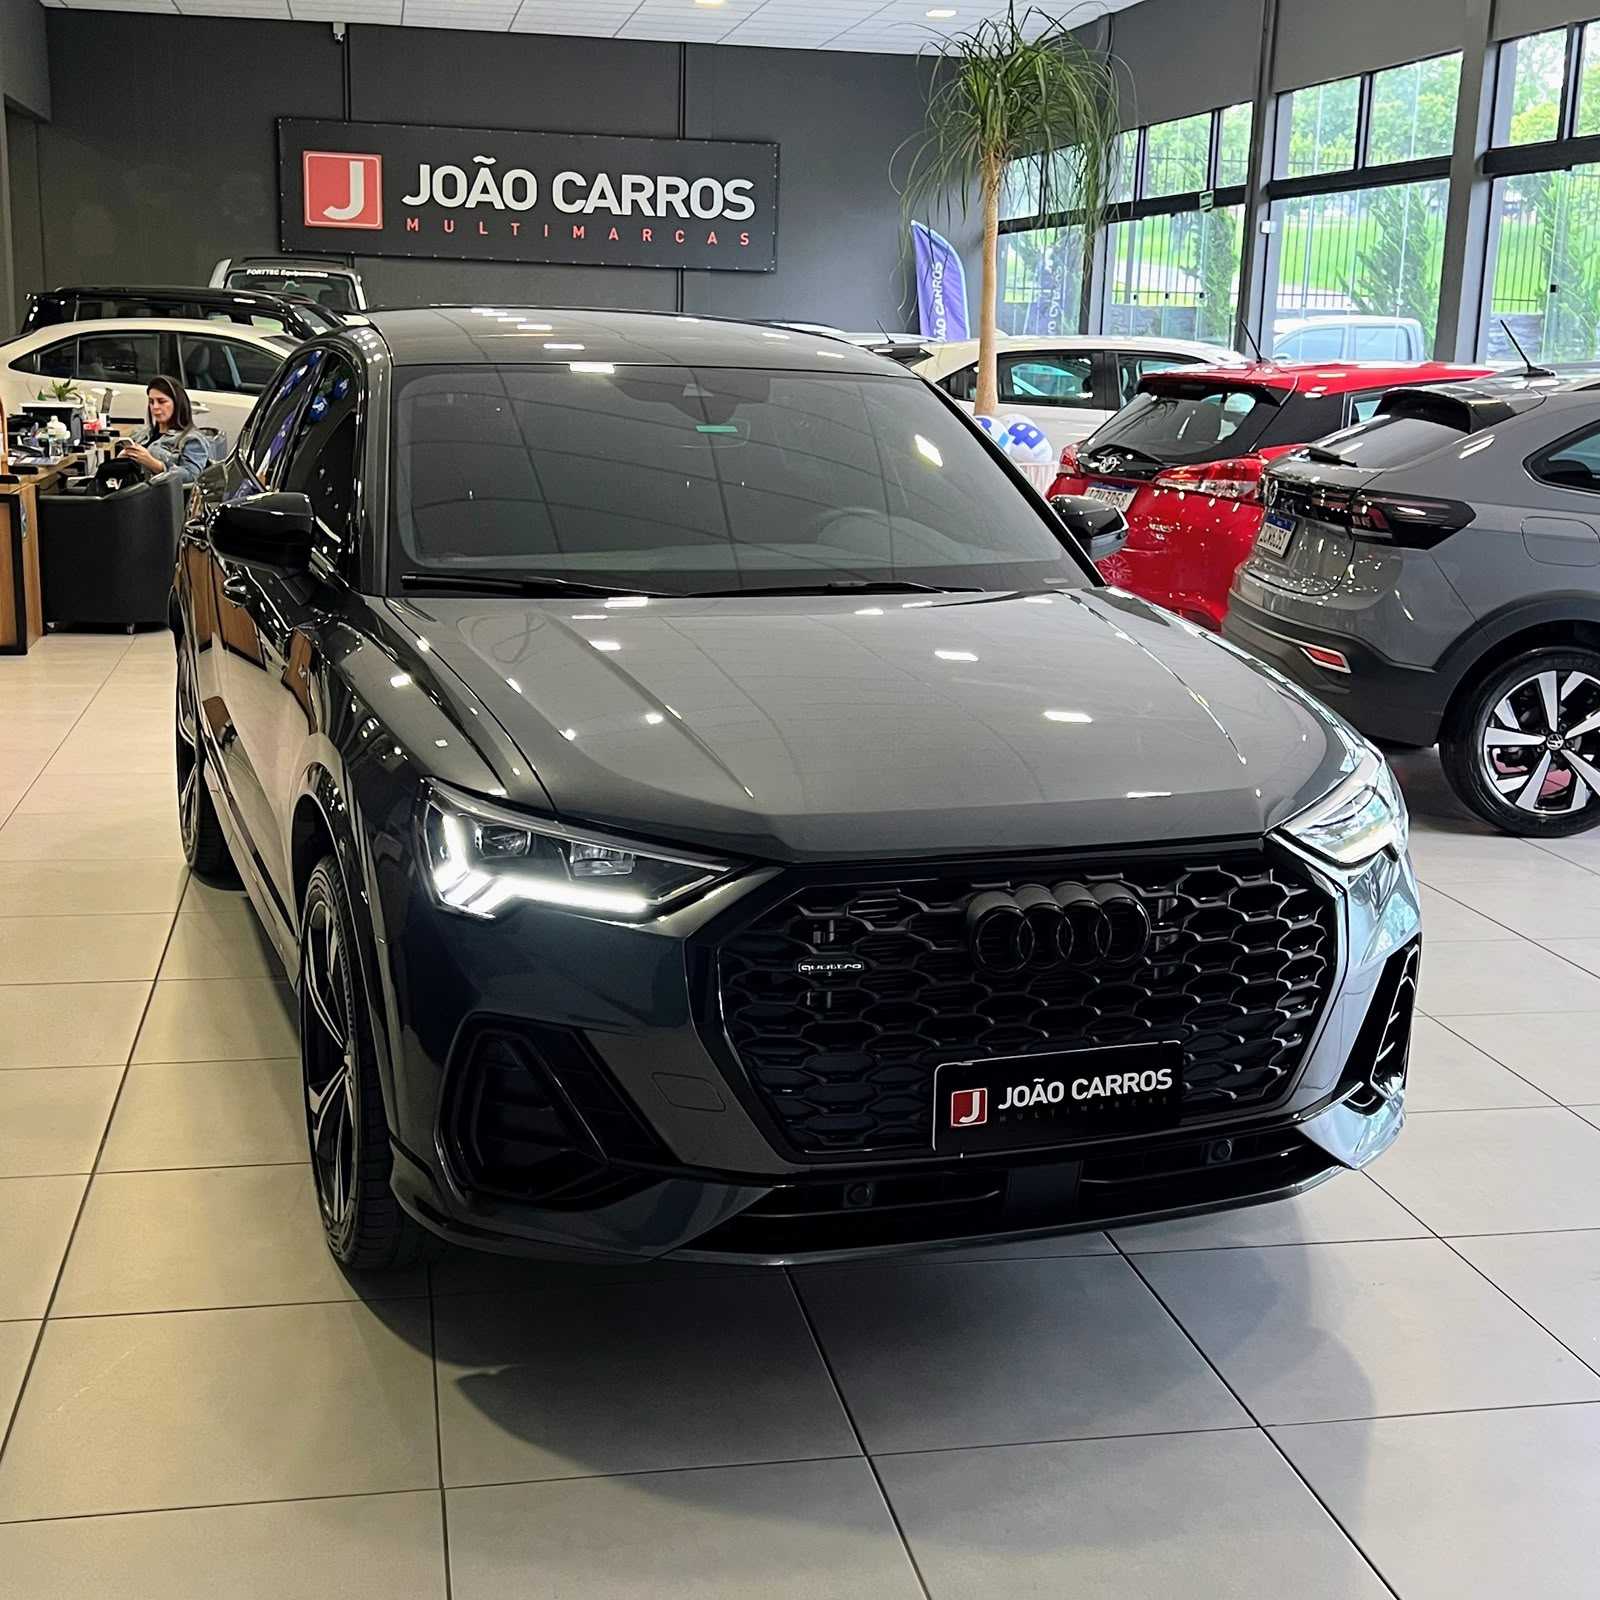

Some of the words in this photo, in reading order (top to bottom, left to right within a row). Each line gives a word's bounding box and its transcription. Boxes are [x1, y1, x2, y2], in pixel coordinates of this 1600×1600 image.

[401, 155, 537, 212] JOÃO
[553, 171, 756, 221] CARROS
[406, 218, 750, 246] MULTIMARCAS
[932, 261, 945, 315] CARROS
[800, 963, 862, 972] quattro
[998, 1077, 1065, 1110] JOÃO
[1071, 1068, 1173, 1102] CARROS
